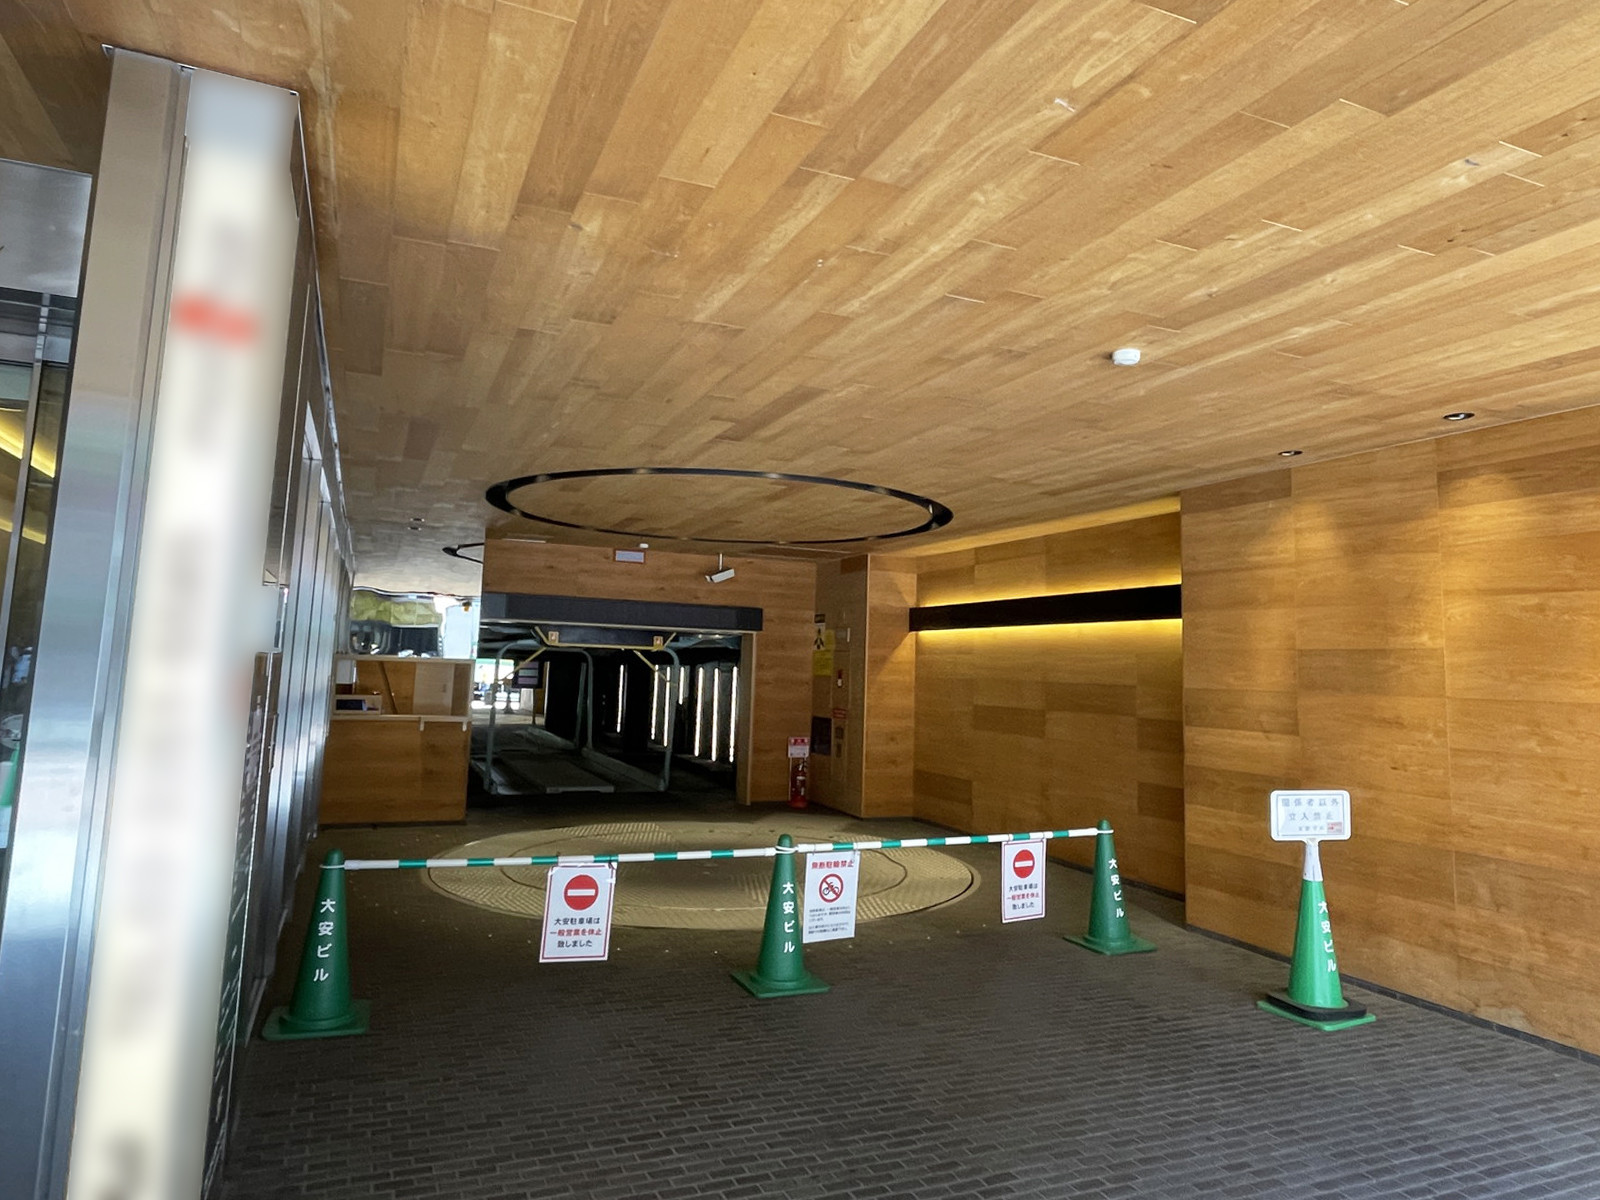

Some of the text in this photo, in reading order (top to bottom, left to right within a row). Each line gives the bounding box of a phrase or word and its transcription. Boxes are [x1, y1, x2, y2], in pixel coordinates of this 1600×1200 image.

[782, 881, 796, 953] 大安ビル
[1108, 858, 1125, 918] 大安ビル
[313, 898, 336, 982] 大安ビル
[550, 927, 602, 937] 一般営業を休止
[554, 917, 600, 926] 大安駐車場は
[557, 940, 592, 948] 致しました
[1317, 900, 1337, 972] 大安ビル
